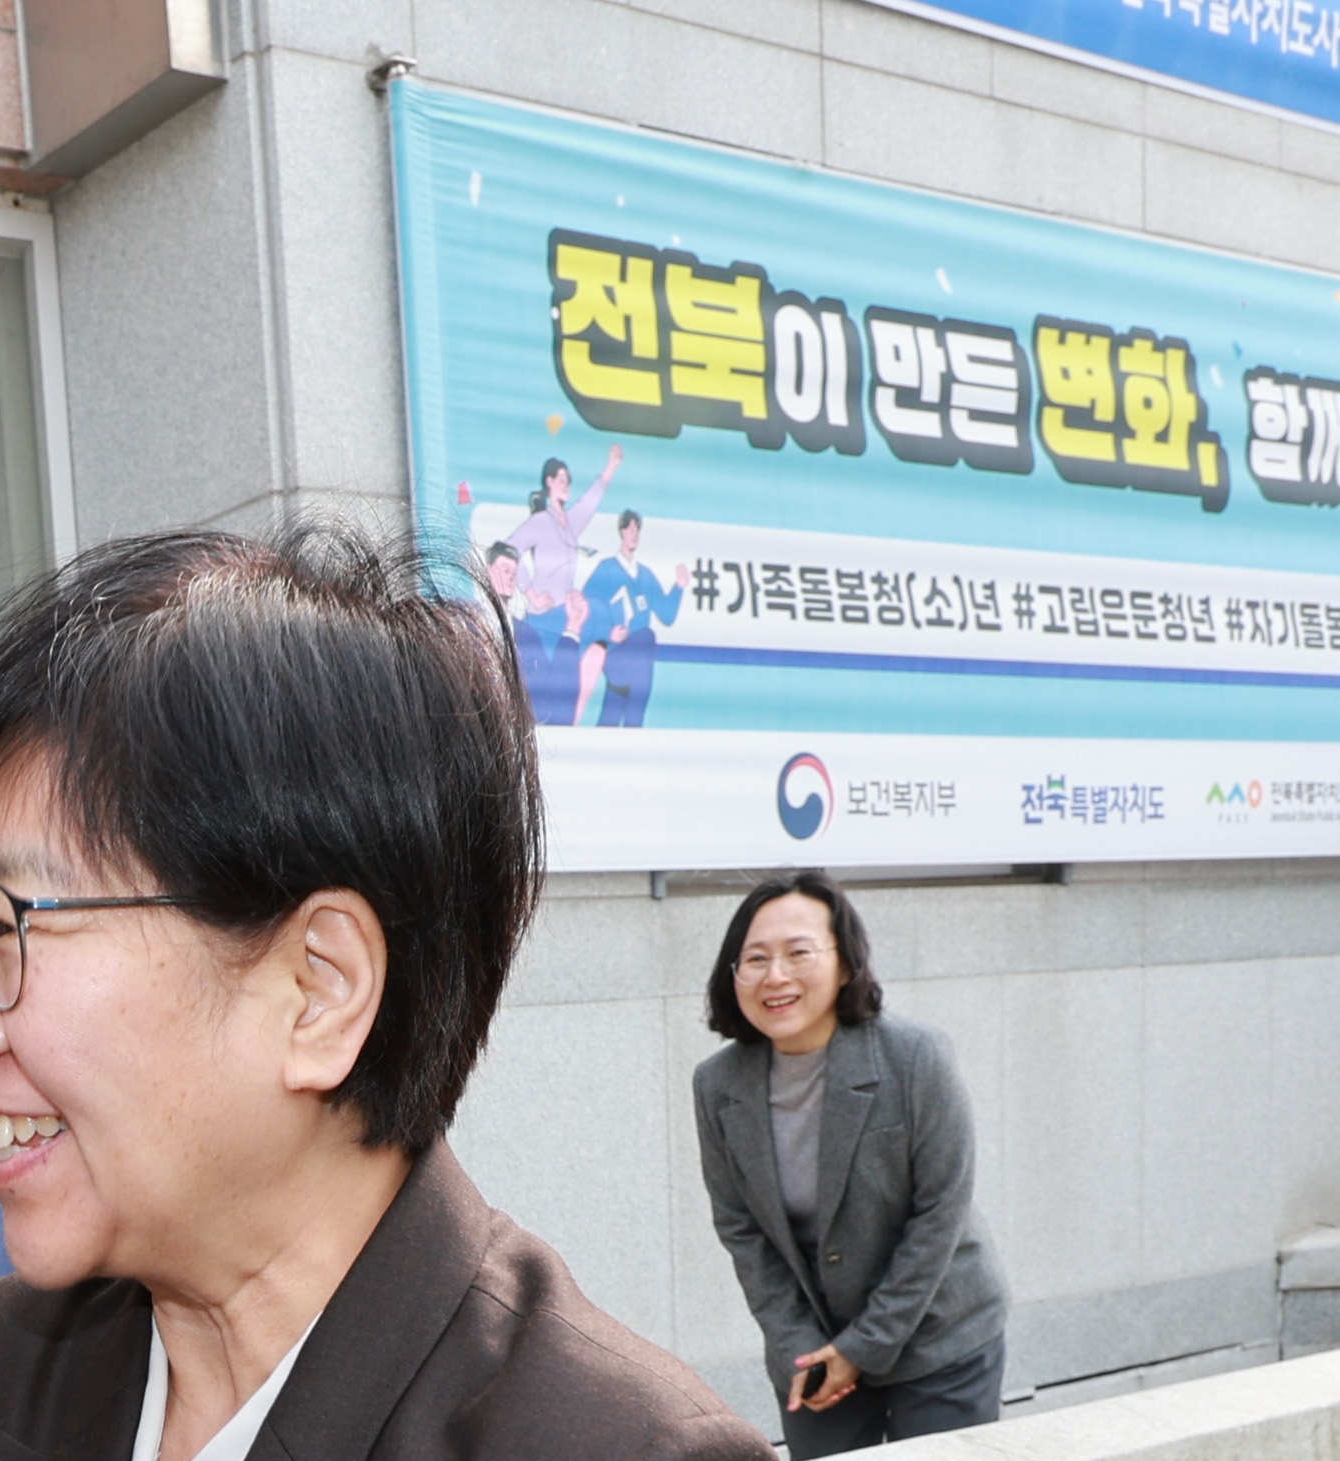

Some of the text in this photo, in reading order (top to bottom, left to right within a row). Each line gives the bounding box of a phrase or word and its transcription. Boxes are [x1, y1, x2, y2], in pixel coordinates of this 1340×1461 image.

[554, 240, 852, 428] 전북이
[868, 315, 1022, 449] 만든
[1035, 324, 1220, 488] 변화,
[692, 557, 1003, 632] #가족돌봄청(소)년
[1012, 581, 1217, 643] #고립은둔청년
[847, 780, 957, 818] 보건복지부
[1021, 774, 1166, 825] 전북특별자치도
